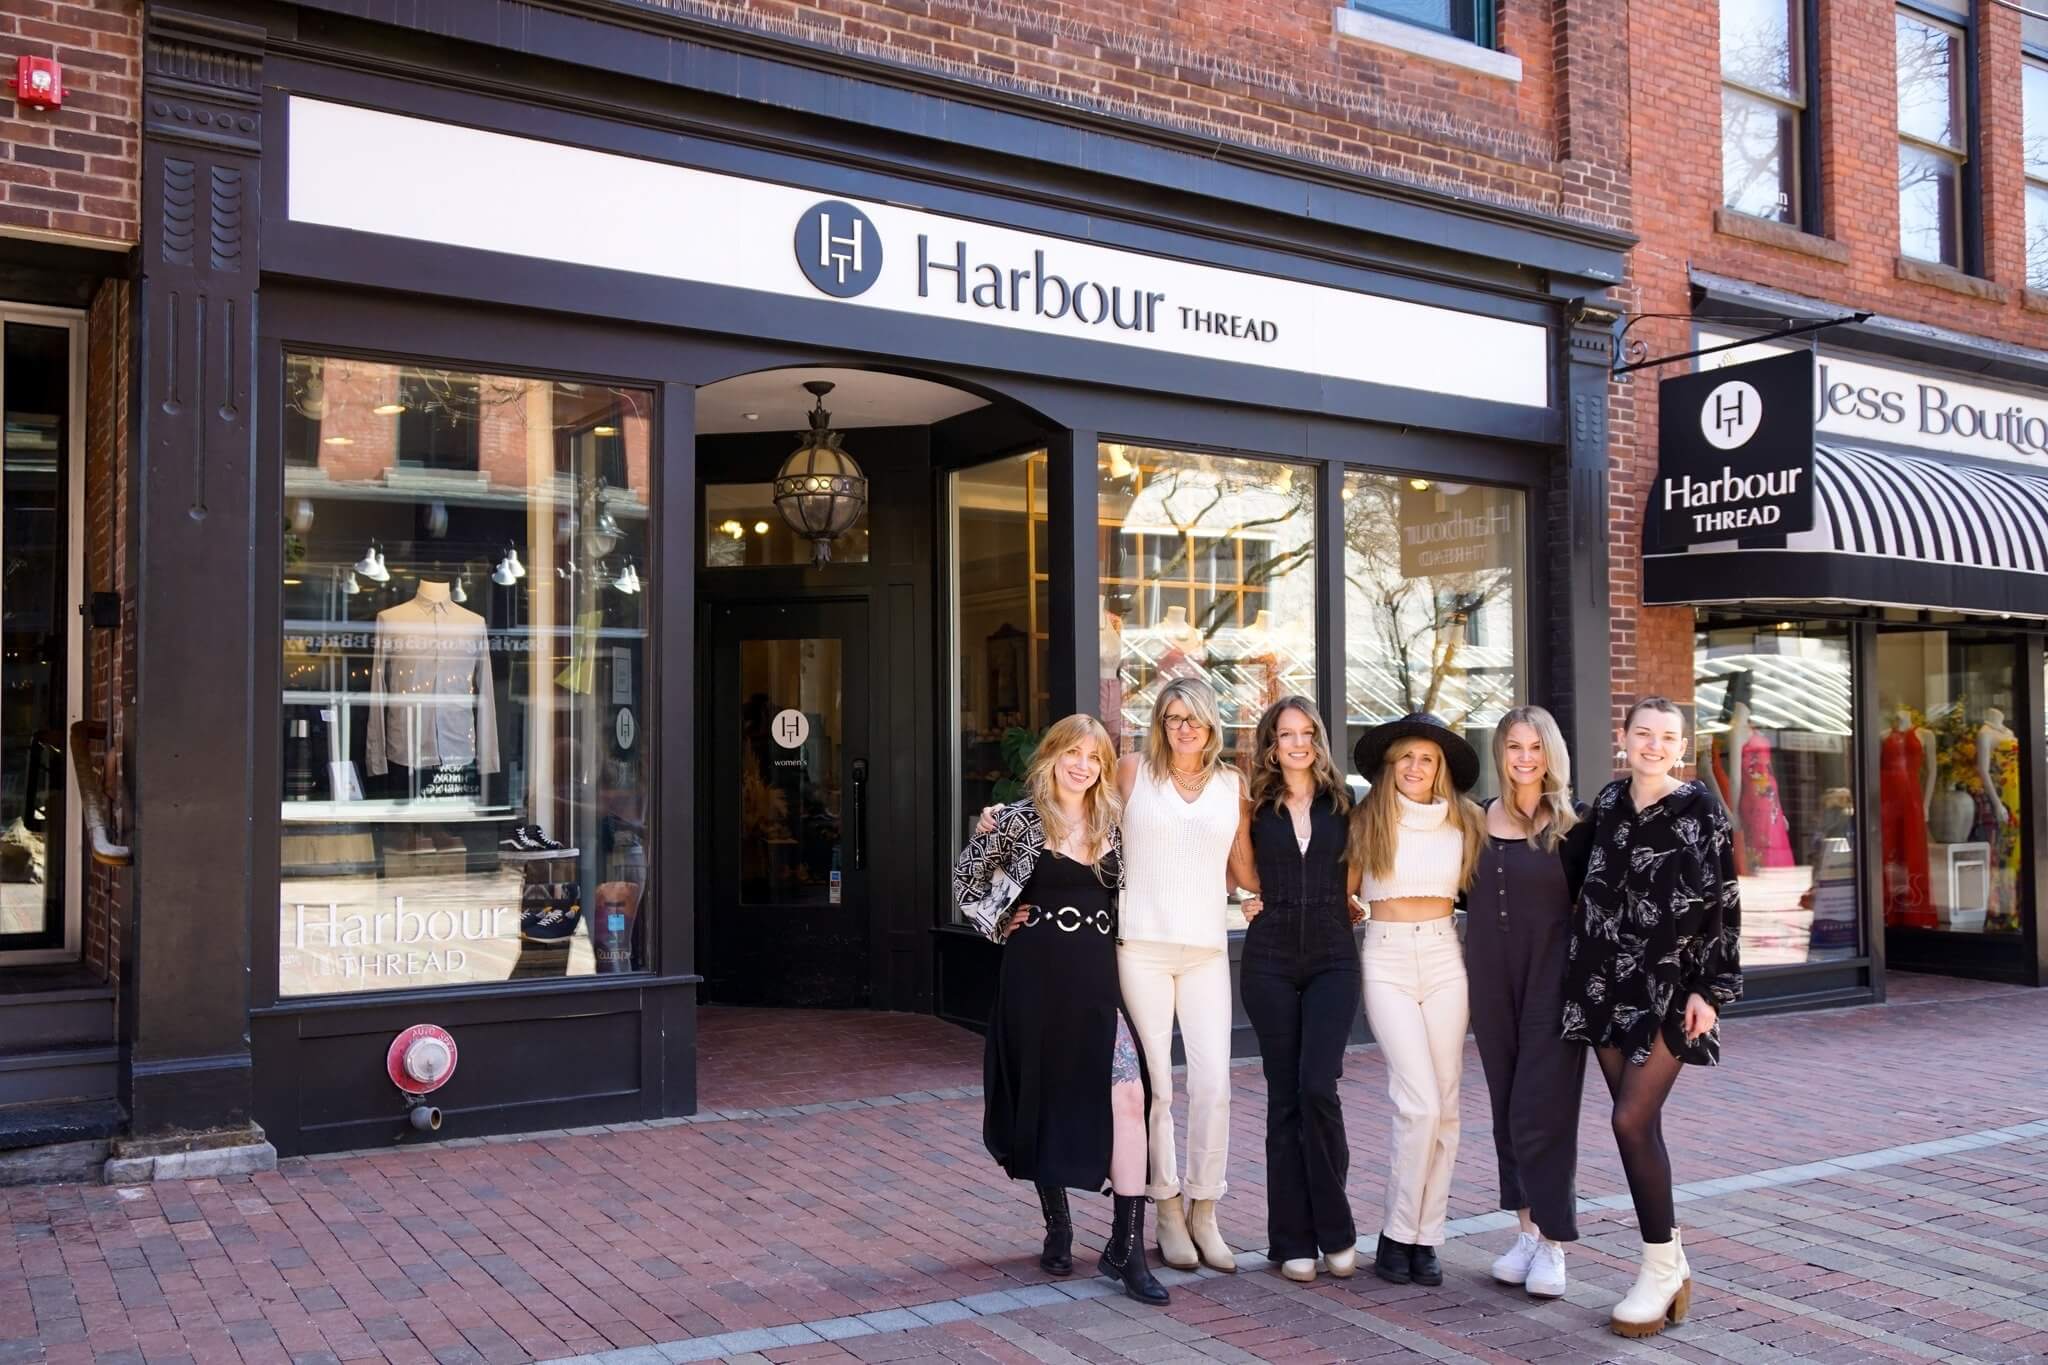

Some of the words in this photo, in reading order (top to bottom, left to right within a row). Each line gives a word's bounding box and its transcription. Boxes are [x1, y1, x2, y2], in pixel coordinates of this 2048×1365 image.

[917, 233, 1165, 333] Harbour
[1178, 306, 1279, 343] THREAD
[1816, 364, 1906, 424] Jess
[1664, 466, 1803, 511] Harbour
[1693, 505, 1781, 533] THREAD
[295, 897, 509, 949] Harbour
[338, 949, 467, 978] THREAD
